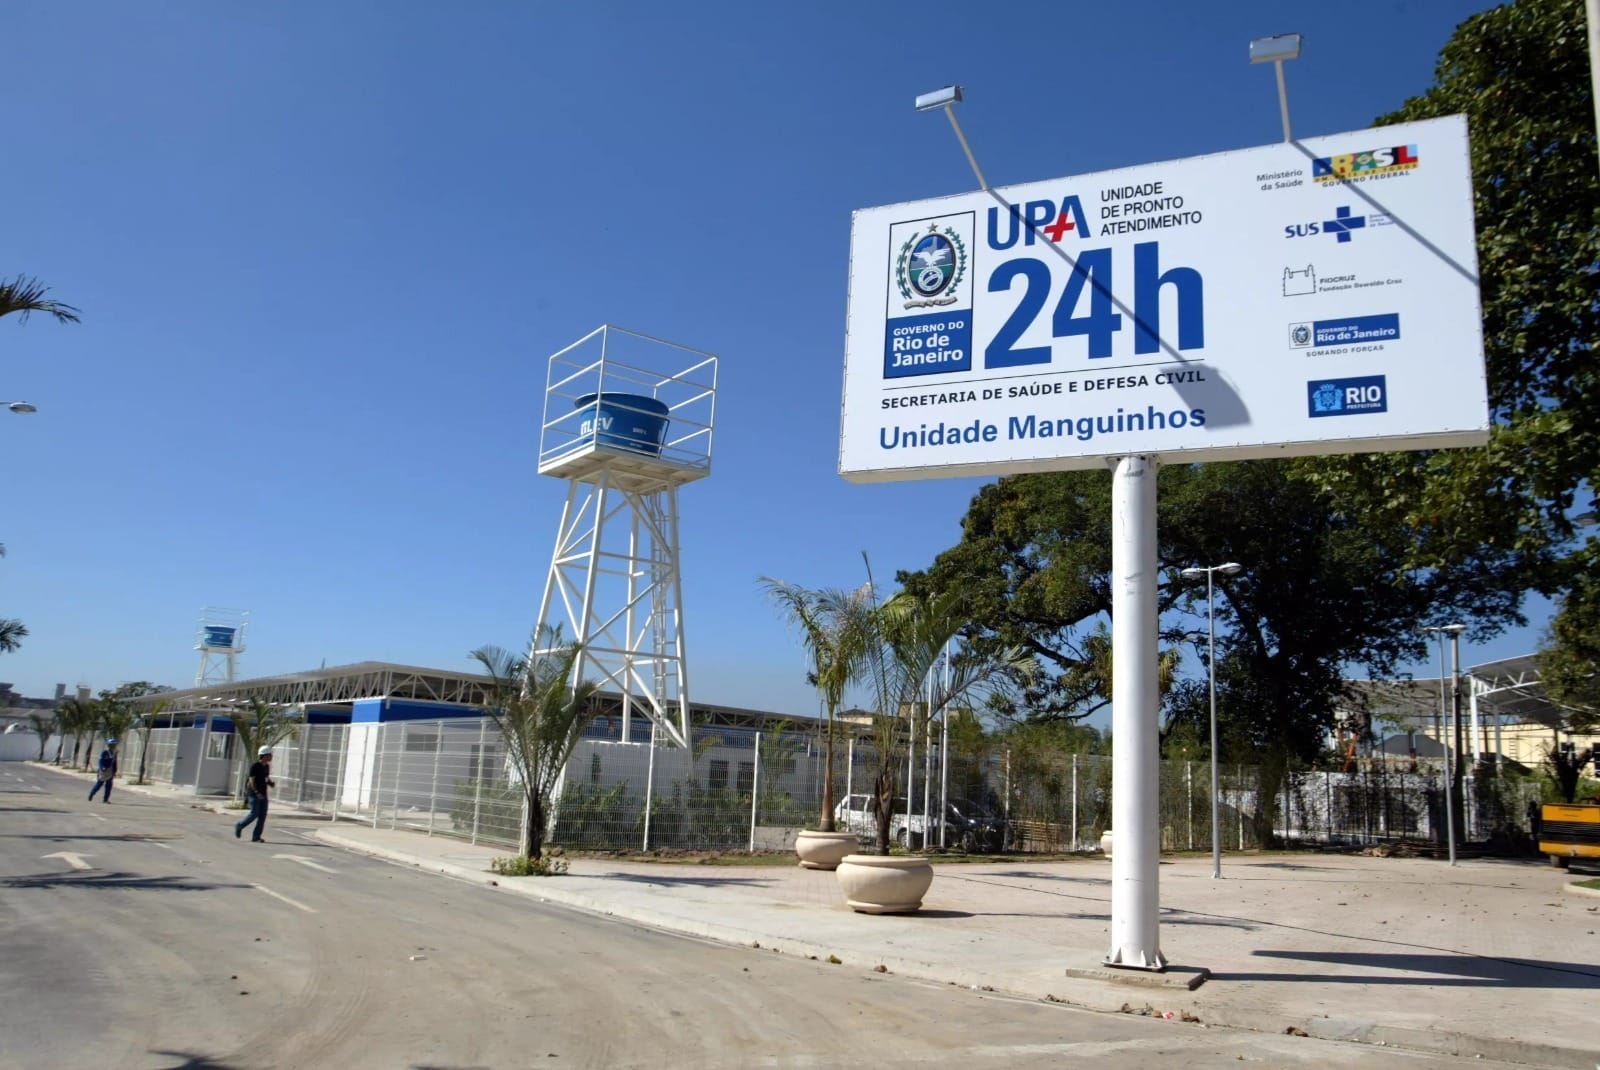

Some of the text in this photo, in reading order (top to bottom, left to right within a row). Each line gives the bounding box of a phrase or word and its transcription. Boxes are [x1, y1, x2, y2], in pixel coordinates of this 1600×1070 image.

[1312, 144, 1418, 177] BRASIL
[1256, 169, 1303, 182] Ministério
[1261, 179, 1303, 191] da Saúde
[1322, 170, 1410, 188] GOVERNO FEDERAL
[1101, 181, 1163, 202] UNIDADE
[1101, 196, 1184, 219] DE PRONTO
[987, 194, 1091, 251] UPA
[1101, 211, 1202, 236] ATENDIMENTO
[1285, 221, 1319, 239] SUS
[1320, 274, 1356, 284] FIOCRUZ
[984, 240, 1205, 370] 24h
[893, 321, 964, 336] GOVERNO DO
[1317, 327, 1396, 342] Rio de Janeiro
[893, 333, 950, 352] Rio de
[1306, 344, 1384, 358] SOMANDO FORÇAS
[892, 348, 964, 367] Janeiro
[881, 370, 1206, 409] SECRETARIA DE SAÚDE E DEFESA CIVIL
[1346, 385, 1382, 404] RIO
[880, 405, 1206, 450] Unidade Manguinhos
